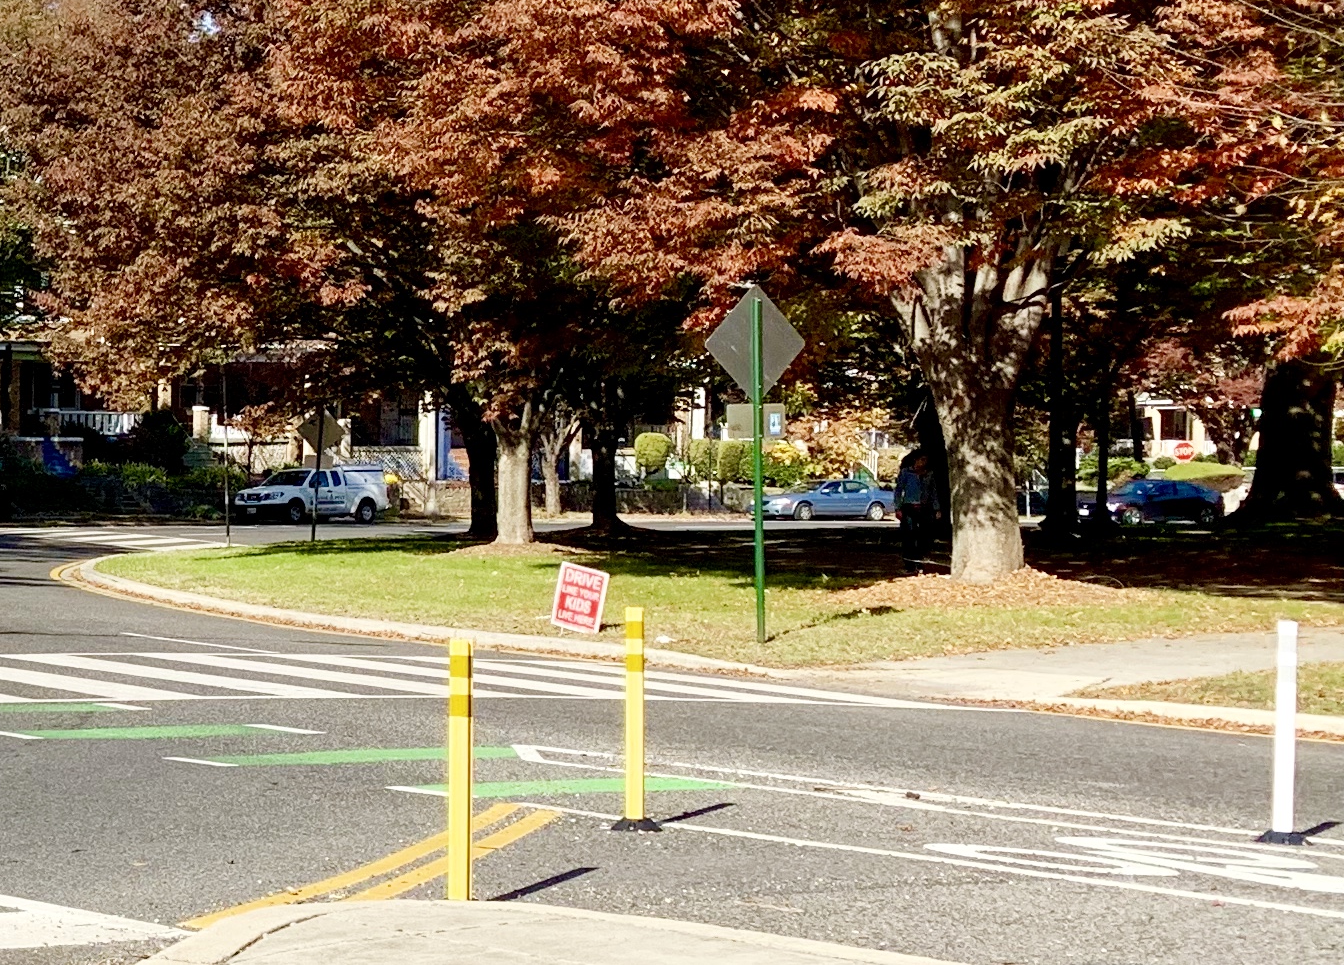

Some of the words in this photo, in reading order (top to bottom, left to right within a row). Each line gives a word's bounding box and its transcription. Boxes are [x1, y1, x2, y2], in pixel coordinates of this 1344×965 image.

[1175, 446, 1193, 455] STOP
[565, 568, 602, 591] DRIVE
[562, 584, 578, 596] LIKE
[579, 588, 600, 601] YOUR
[565, 595, 592, 614] KIDS
